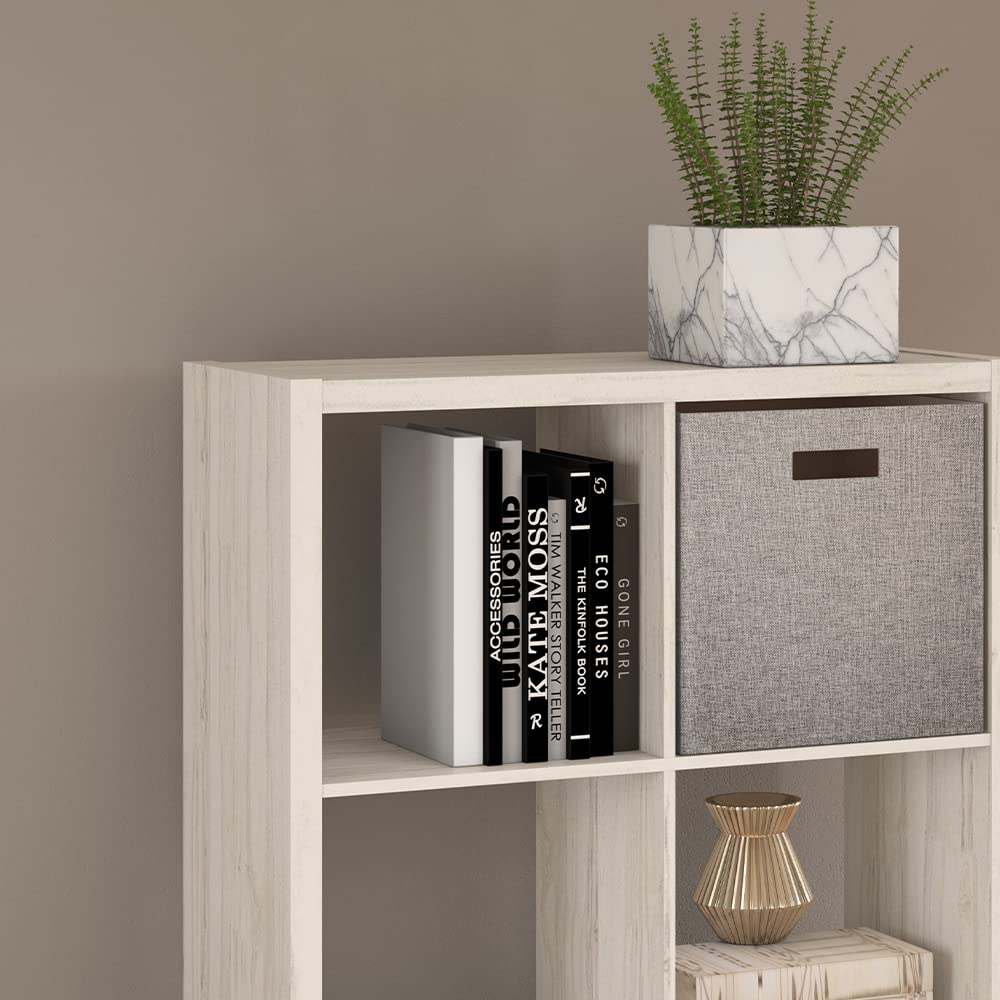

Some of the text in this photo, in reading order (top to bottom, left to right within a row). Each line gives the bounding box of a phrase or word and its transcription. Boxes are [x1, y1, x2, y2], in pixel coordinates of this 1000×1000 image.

[490, 530, 501, 661] ACCESSORIES
[502, 496, 520, 688] WILD WORLD
[528, 507, 548, 701] KATE MOSS
[551, 532, 561, 741] TIM WALKER STORY TELLER
[577, 567, 587, 695] THE KINFOLK BOOK
[595, 554, 609, 679] ECO HOUSES
[618, 578, 630, 679] GONE GIRL
